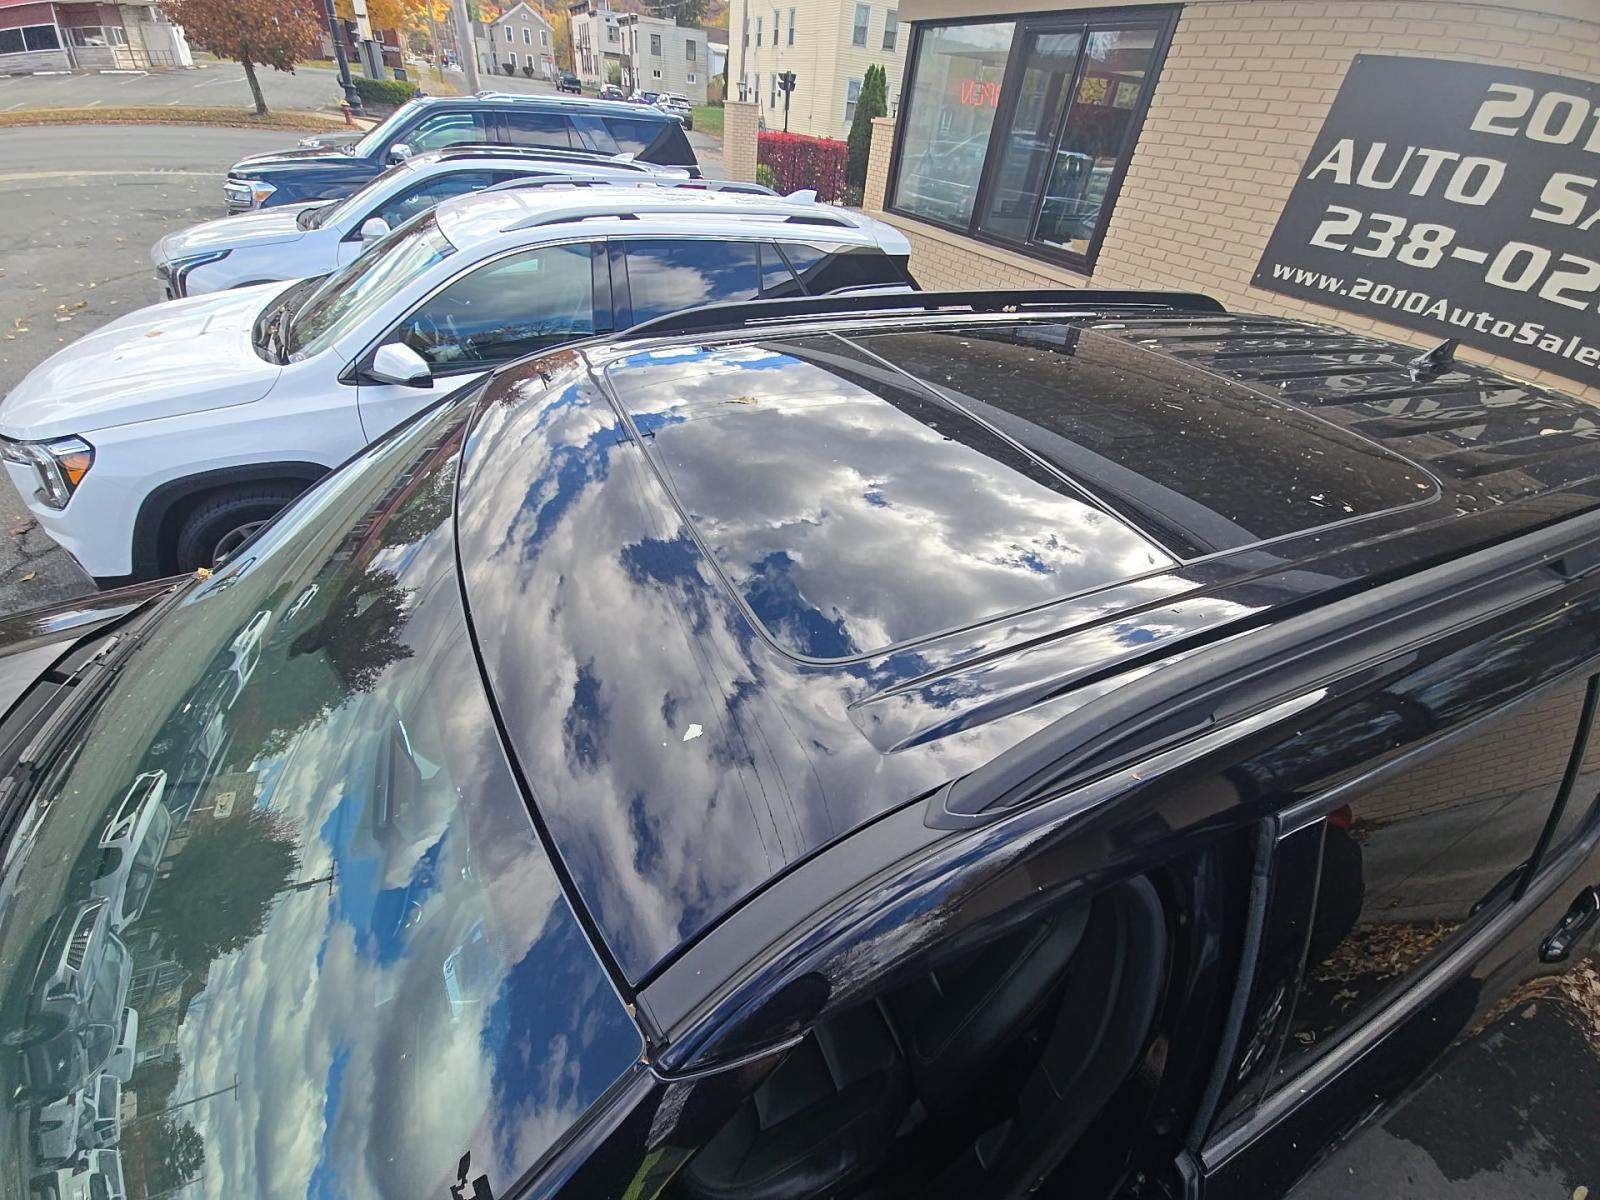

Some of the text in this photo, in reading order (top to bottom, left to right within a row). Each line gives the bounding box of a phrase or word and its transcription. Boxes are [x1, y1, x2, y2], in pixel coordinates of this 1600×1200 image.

[1306, 138, 1600, 231] AUTO S
[1308, 204, 1600, 312] 238-02
[1272, 263, 1600, 369] www.2010AutoSale
